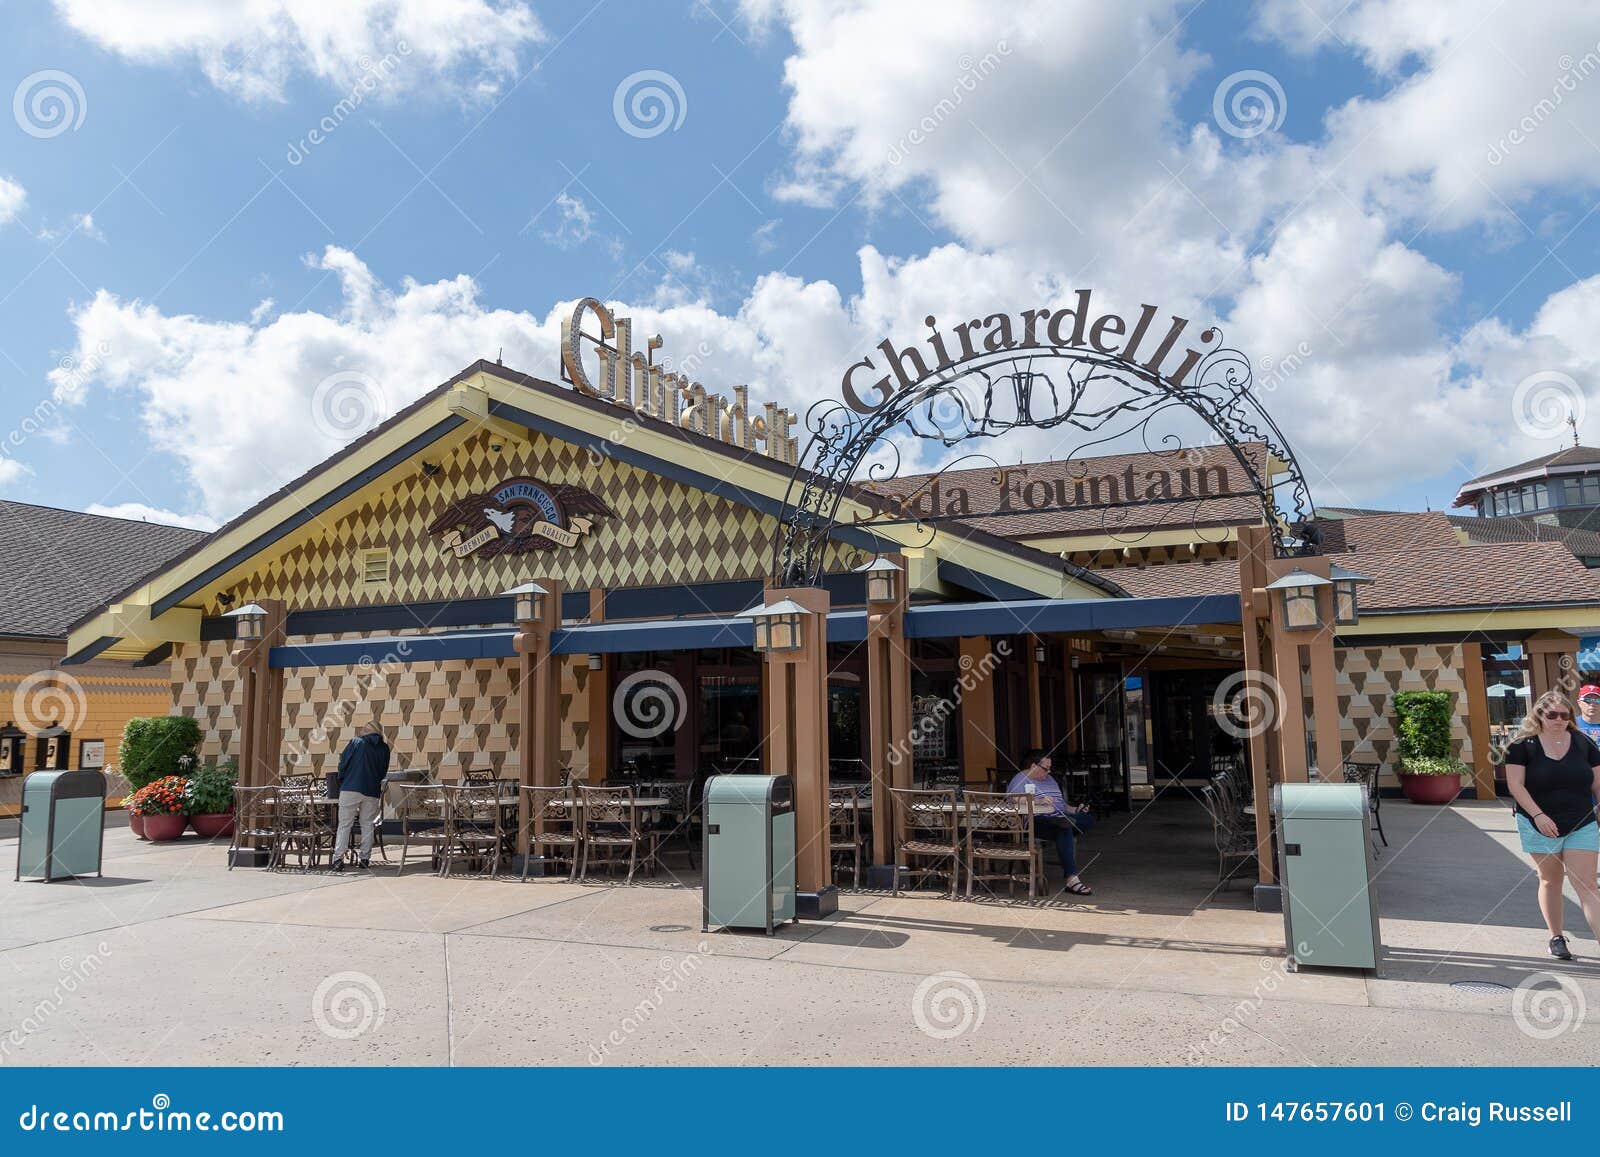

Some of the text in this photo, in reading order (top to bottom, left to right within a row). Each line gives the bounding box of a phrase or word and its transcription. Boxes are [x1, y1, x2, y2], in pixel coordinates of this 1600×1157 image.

[842, 289, 1214, 414] Ghirardelli
[994, 455, 1231, 511] Fountain
[500, 486, 556, 521] SAN FRANCISCO
[459, 530, 492, 555] PREMIUM
[542, 524, 572, 544] QUALITY
